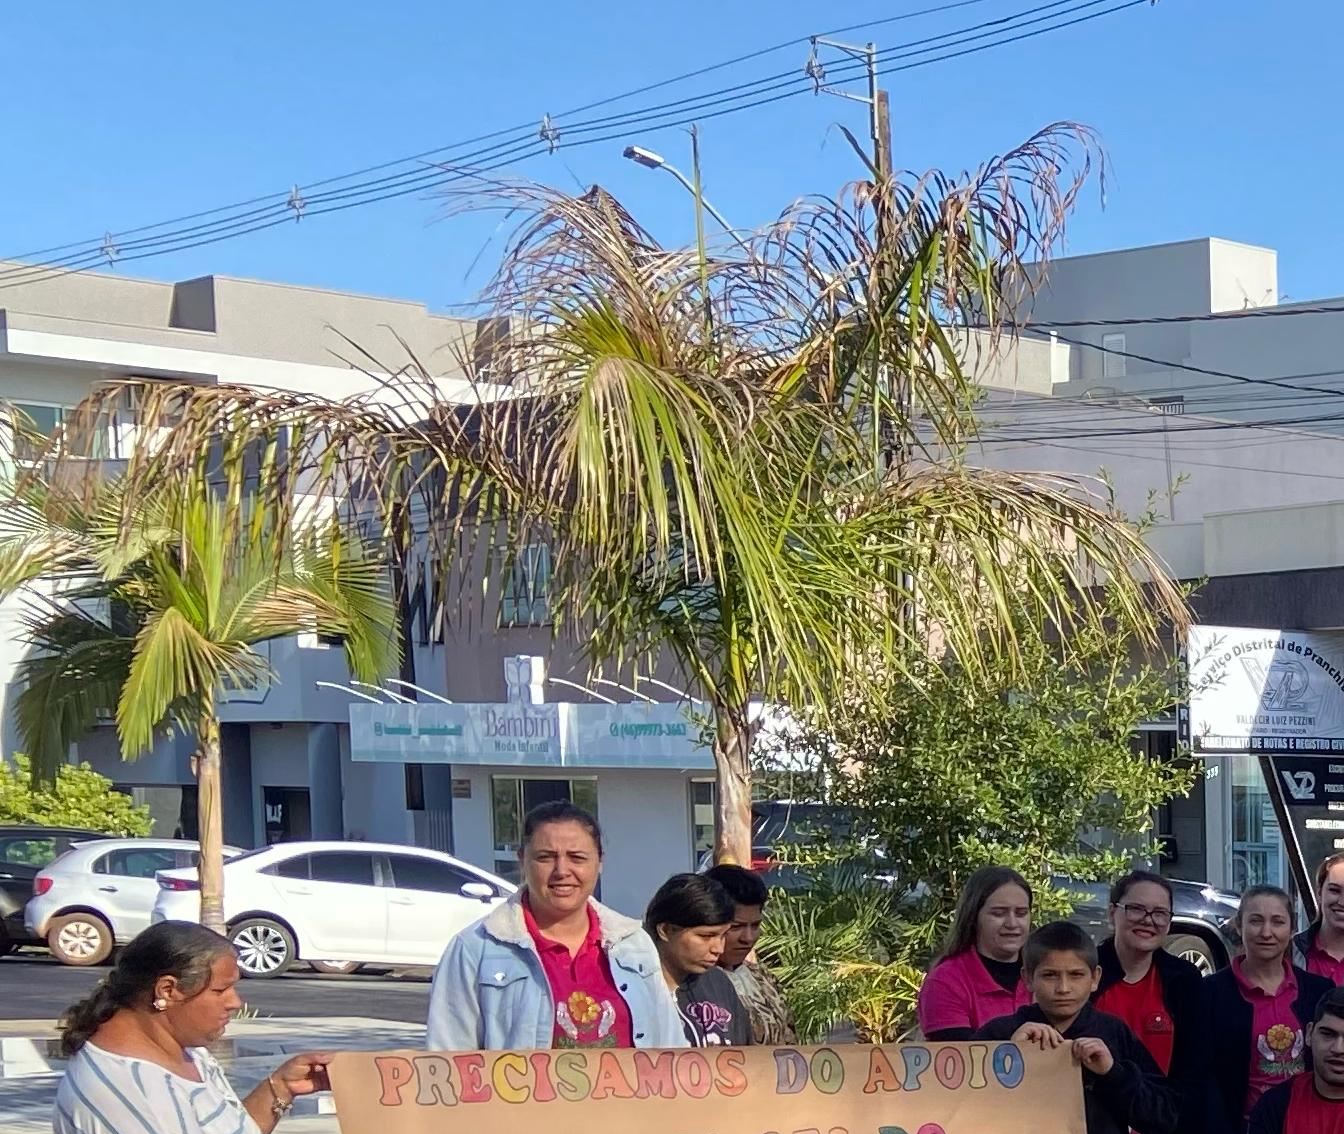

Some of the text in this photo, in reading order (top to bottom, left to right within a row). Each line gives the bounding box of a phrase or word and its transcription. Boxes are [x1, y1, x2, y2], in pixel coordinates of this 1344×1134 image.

[1232, 638, 1286, 657] Distrital
[1287, 640, 1301, 654] de
[1271, 714, 1287, 726] LUIZ
[1251, 737, 1262, 749] DE
[375, 1042, 1025, 1107] PRECISAMOS DO APOIO
